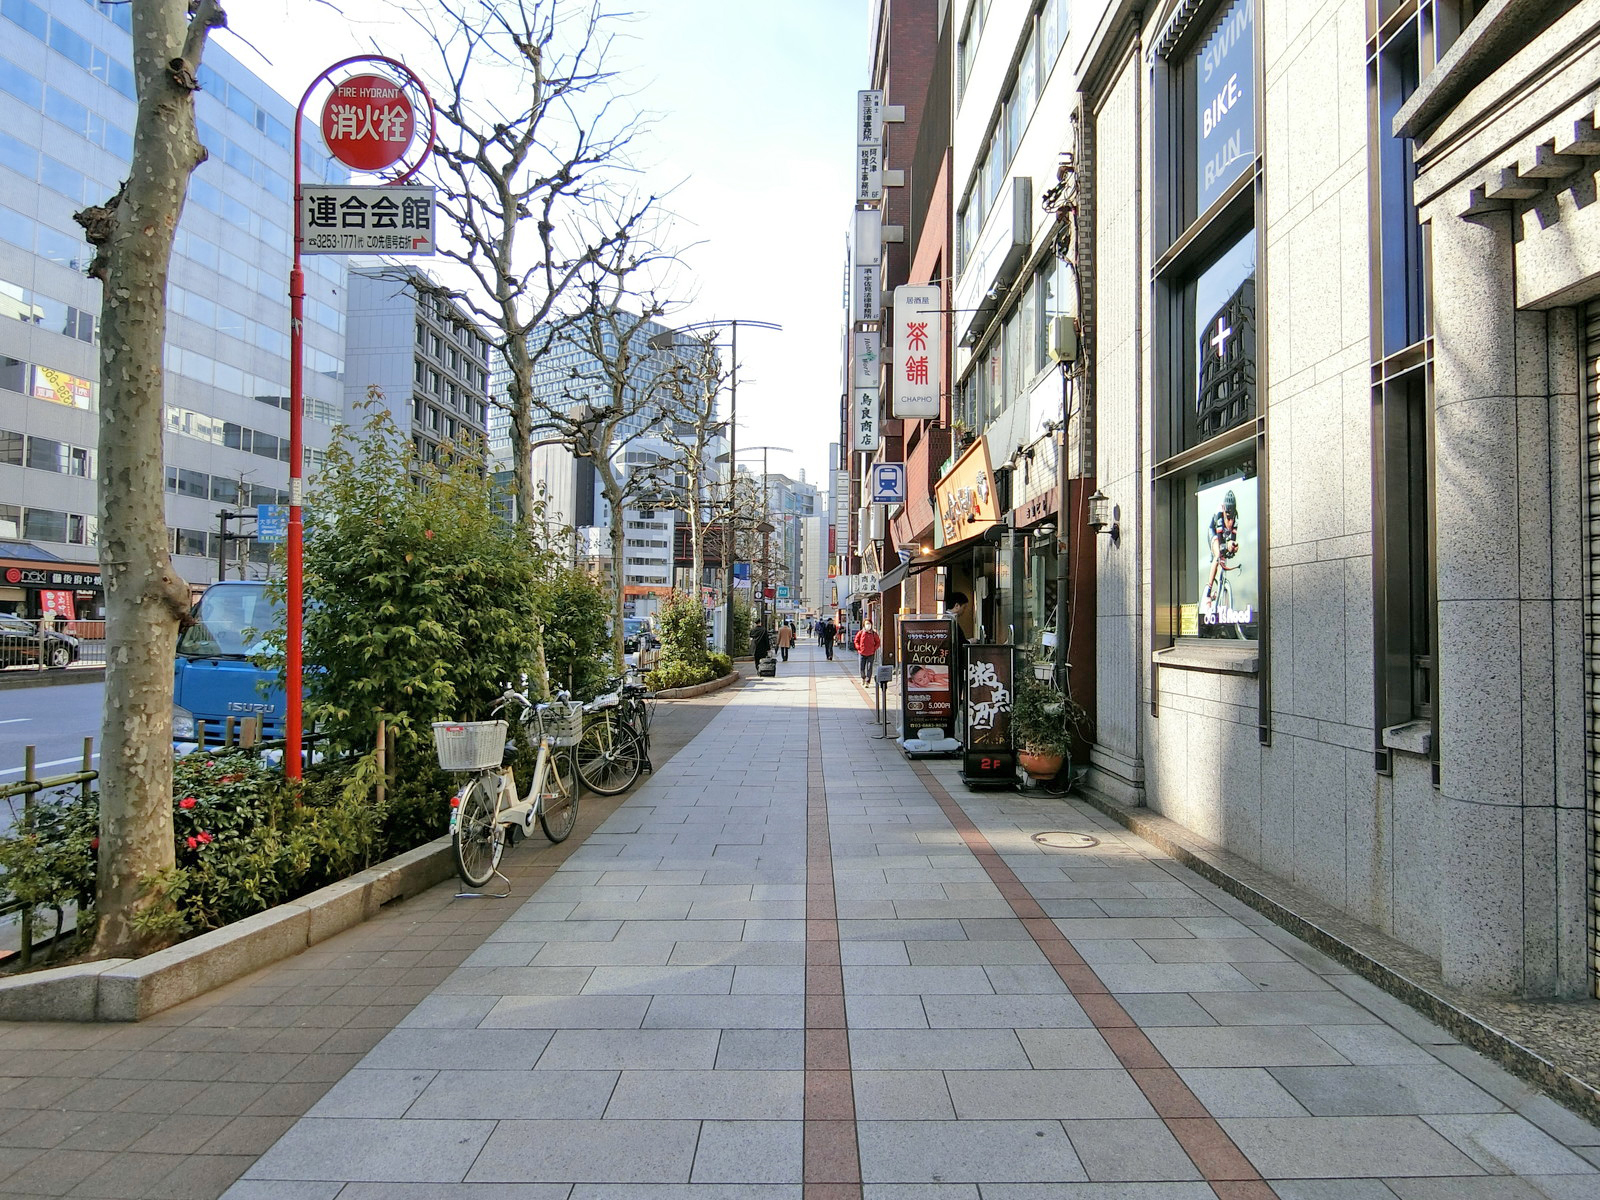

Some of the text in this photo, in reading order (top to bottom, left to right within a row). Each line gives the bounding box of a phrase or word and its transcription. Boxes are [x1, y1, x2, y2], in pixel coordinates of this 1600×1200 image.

[1204, 0, 1253, 83] SWIM
[338, 87, 400, 99] FIRE HYDRANT
[330, 104, 408, 142] 消火栓
[869, 148, 877, 173] 阿久津
[1204, 128, 1241, 192] RUN
[861, 150, 869, 197] 税理士事務所
[308, 195, 431, 230] 連合会館
[366, 235, 411, 250] この先信号右折
[905, 296, 930, 304] 居酒屋
[900, 395, 932, 403] CHAPHO
[907, 640, 937, 655] Lucky
[939, 648, 950, 657] 3F
[912, 653, 946, 664] Aroma
[228, 702, 275, 713] ISUZU
[980, 758, 1001, 769] 2F
